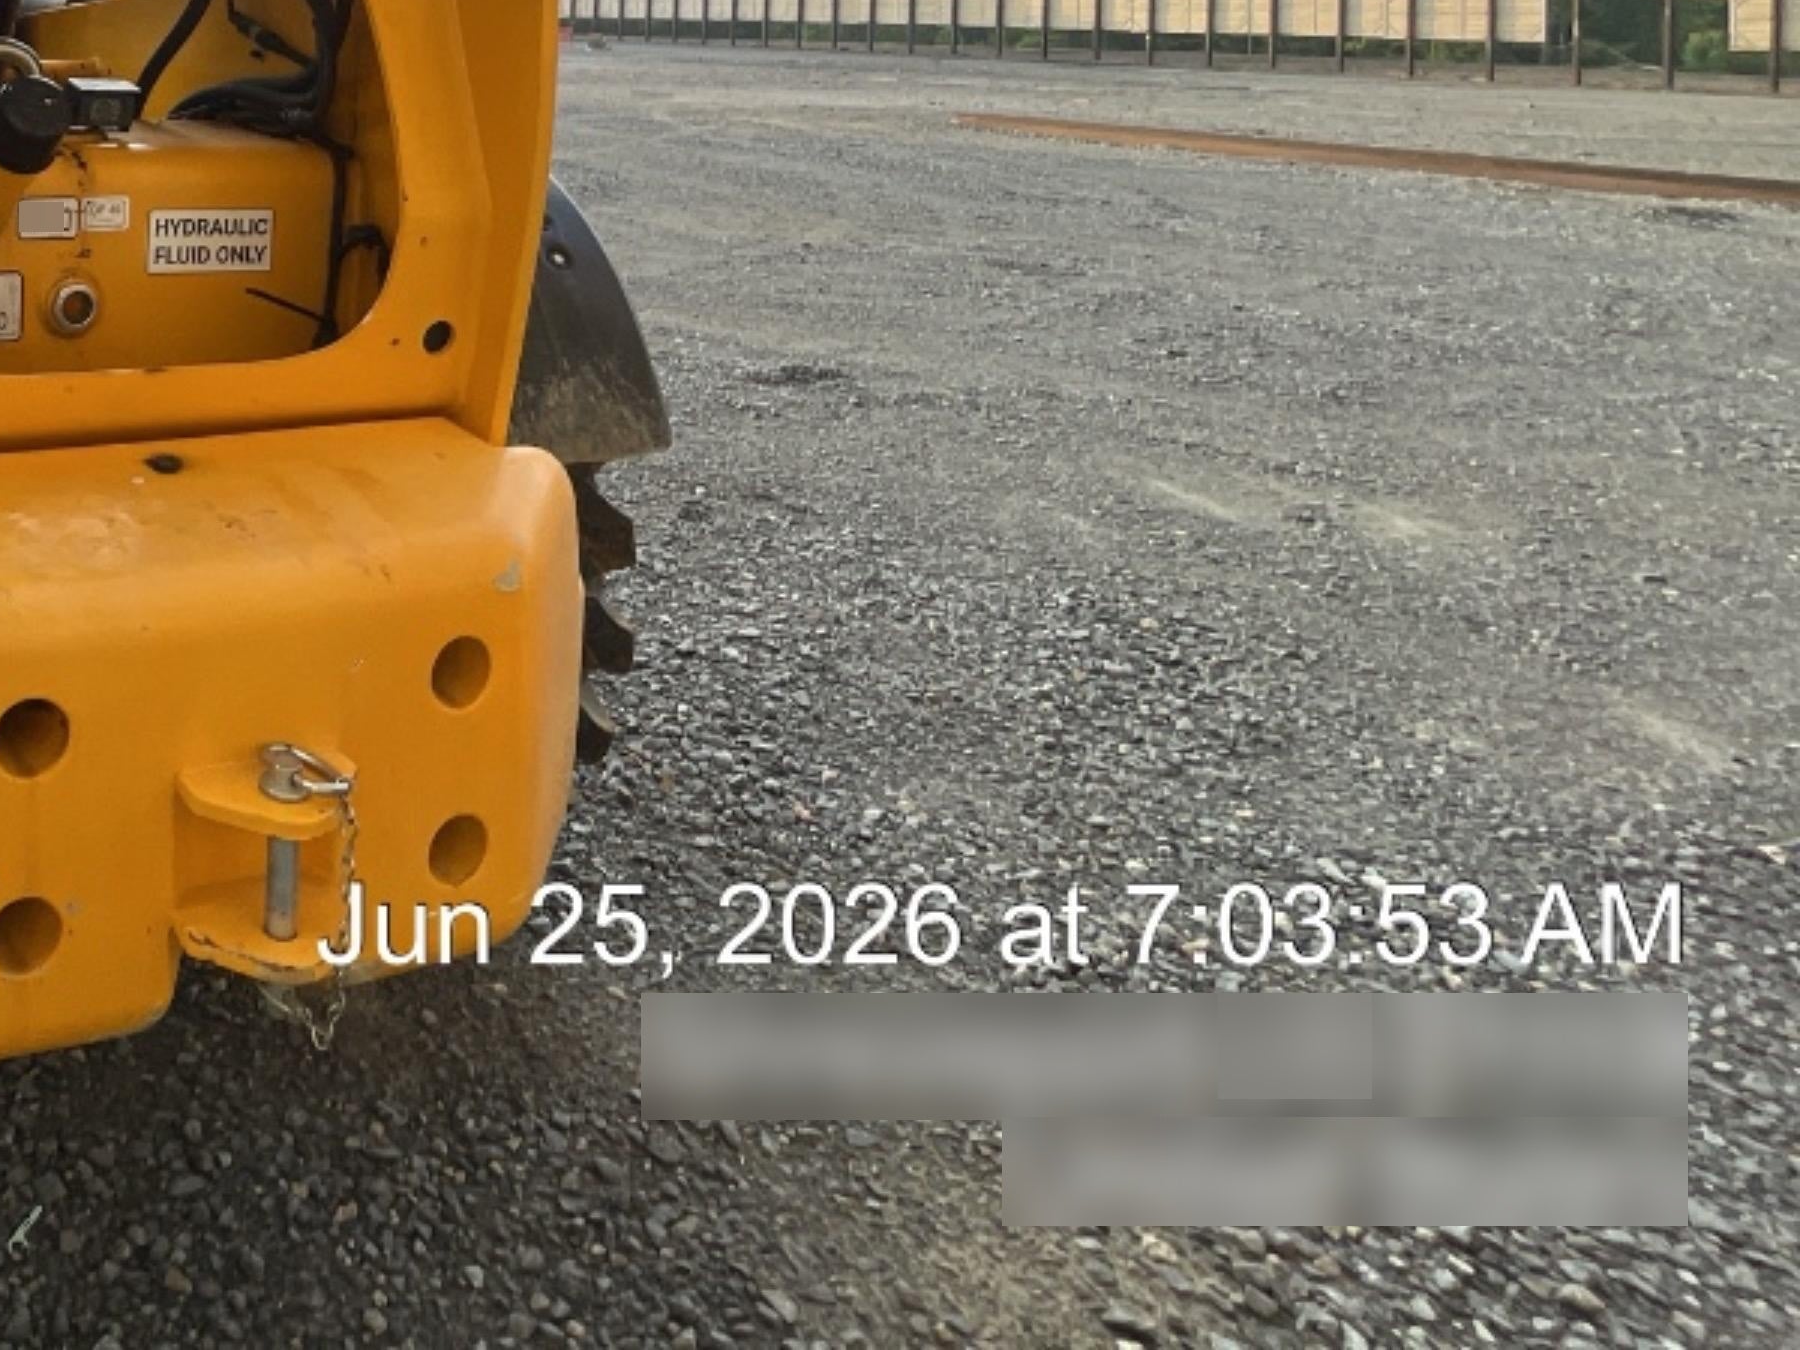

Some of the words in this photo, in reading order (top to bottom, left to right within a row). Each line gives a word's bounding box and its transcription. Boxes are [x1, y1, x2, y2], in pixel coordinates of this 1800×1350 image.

[155, 218, 268, 238] HYDRAULIC
[153, 245, 211, 265] FLUID
[216, 245, 267, 264] ONLY
